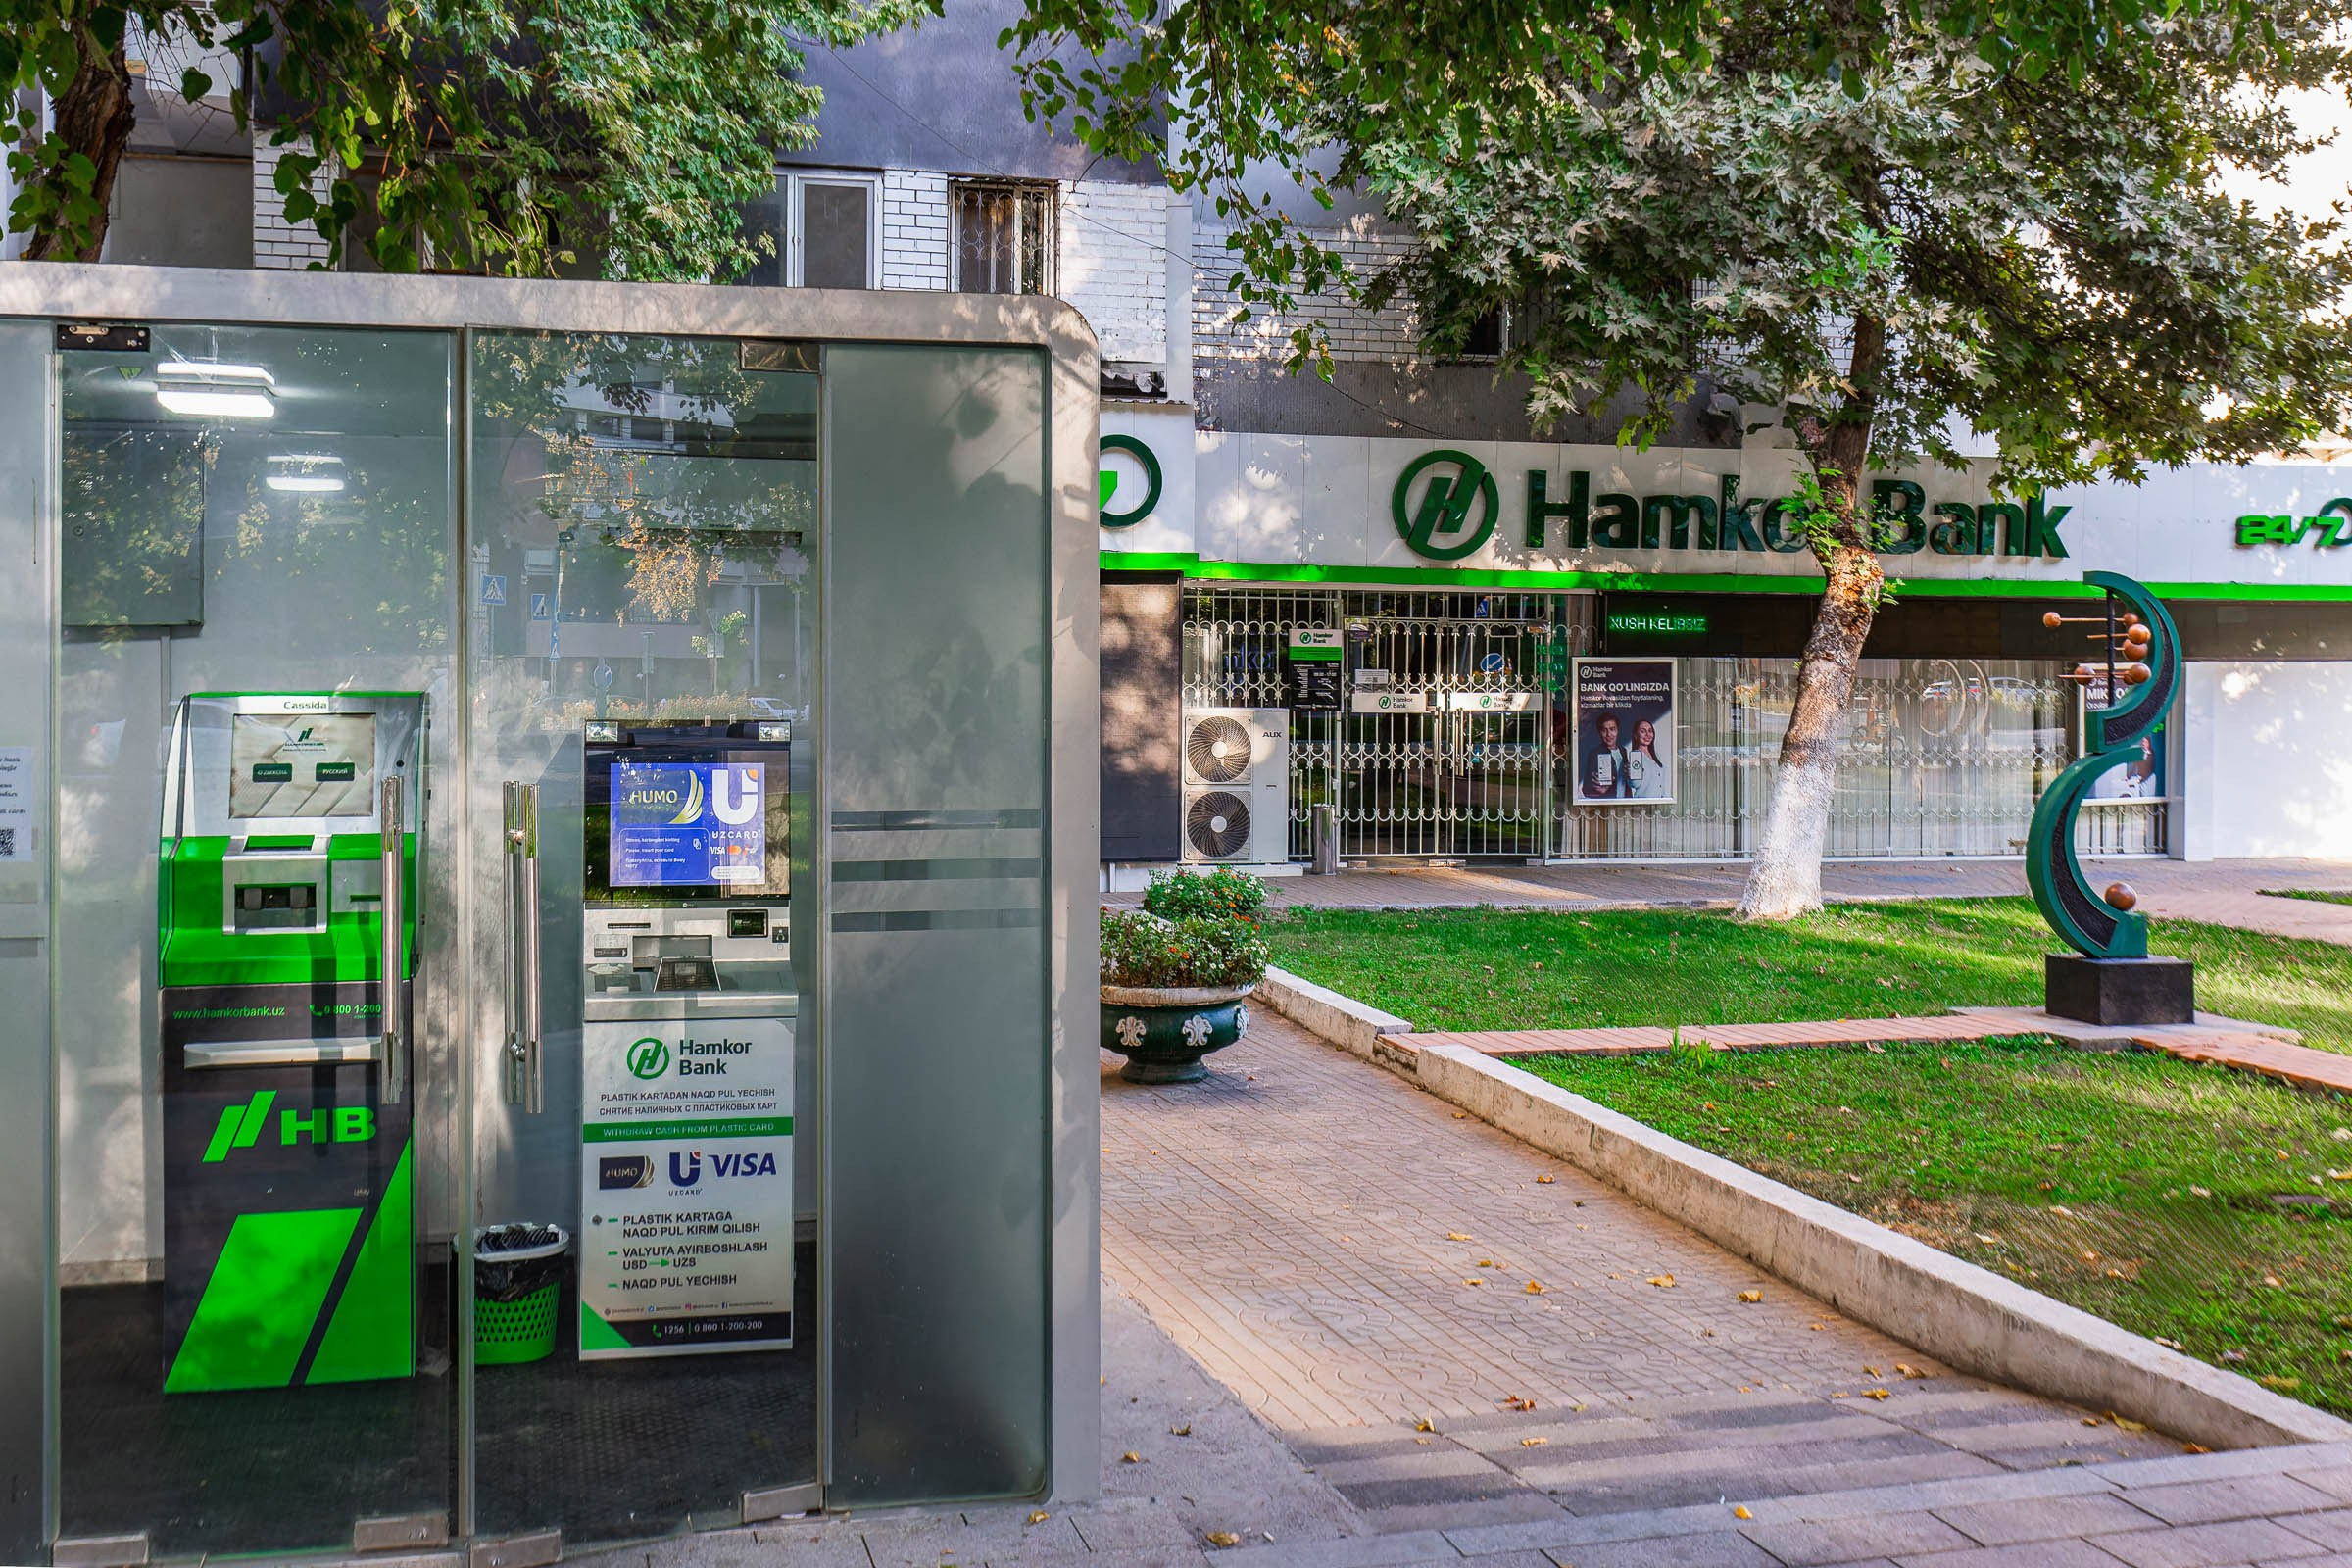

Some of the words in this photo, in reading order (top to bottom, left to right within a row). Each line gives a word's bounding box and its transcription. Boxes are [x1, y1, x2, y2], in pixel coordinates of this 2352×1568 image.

[1526, 469, 1813, 554] Hamko
[1873, 479, 2072, 558] Bank
[2235, 514, 2344, 546] 24/7
[1609, 616, 1647, 630] XUSH
[1580, 683, 1607, 692] BANK
[1608, 682, 1670, 692] QO'LINGIZDA
[283, 701, 327, 710] Cassida
[629, 790, 678, 804] HUMO
[711, 830, 759, 839] UZCARD
[710, 846, 726, 855] VISA
[172, 1005, 285, 1019] www.hamkorbank.uz
[679, 1039, 752, 1055] Hamkor
[679, 1058, 727, 1076] Bank
[737, 1088, 775, 1097] YECHISH
[600, 1106, 633, 1115] СНЯТИЕ
[635, 1105, 682, 1114] НАЛИЧНЫХ
[693, 1102, 754, 1112] ПЛАСТИКОВЫХ
[280, 1106, 377, 1145] HB
[604, 1128, 653, 1137] WITHDRAW
[682, 1125, 708, 1134] FROM
[710, 1124, 746, 1133] PLASTIC
[707, 1152, 777, 1177] VISA
[606, 1167, 638, 1178] HUMO
[623, 1214, 672, 1225] PLASTIK
[676, 1212, 733, 1223] KARTAGA
[623, 1227, 658, 1238] NAQD
[661, 1226, 683, 1237] PUL
[687, 1225, 719, 1235] KIRIM
[722, 1223, 760, 1234] QILISH
[622, 1247, 675, 1257] VALYUTA
[677, 1242, 767, 1255] AYIRBOSHLASH
[622, 1260, 647, 1270] USD
[673, 1258, 697, 1268] UZS
[623, 1279, 657, 1290] NAQD
[660, 1277, 683, 1288] PUL
[686, 1275, 737, 1286] YECHISH
[721, 1321, 762, 1331] 1-200-200
